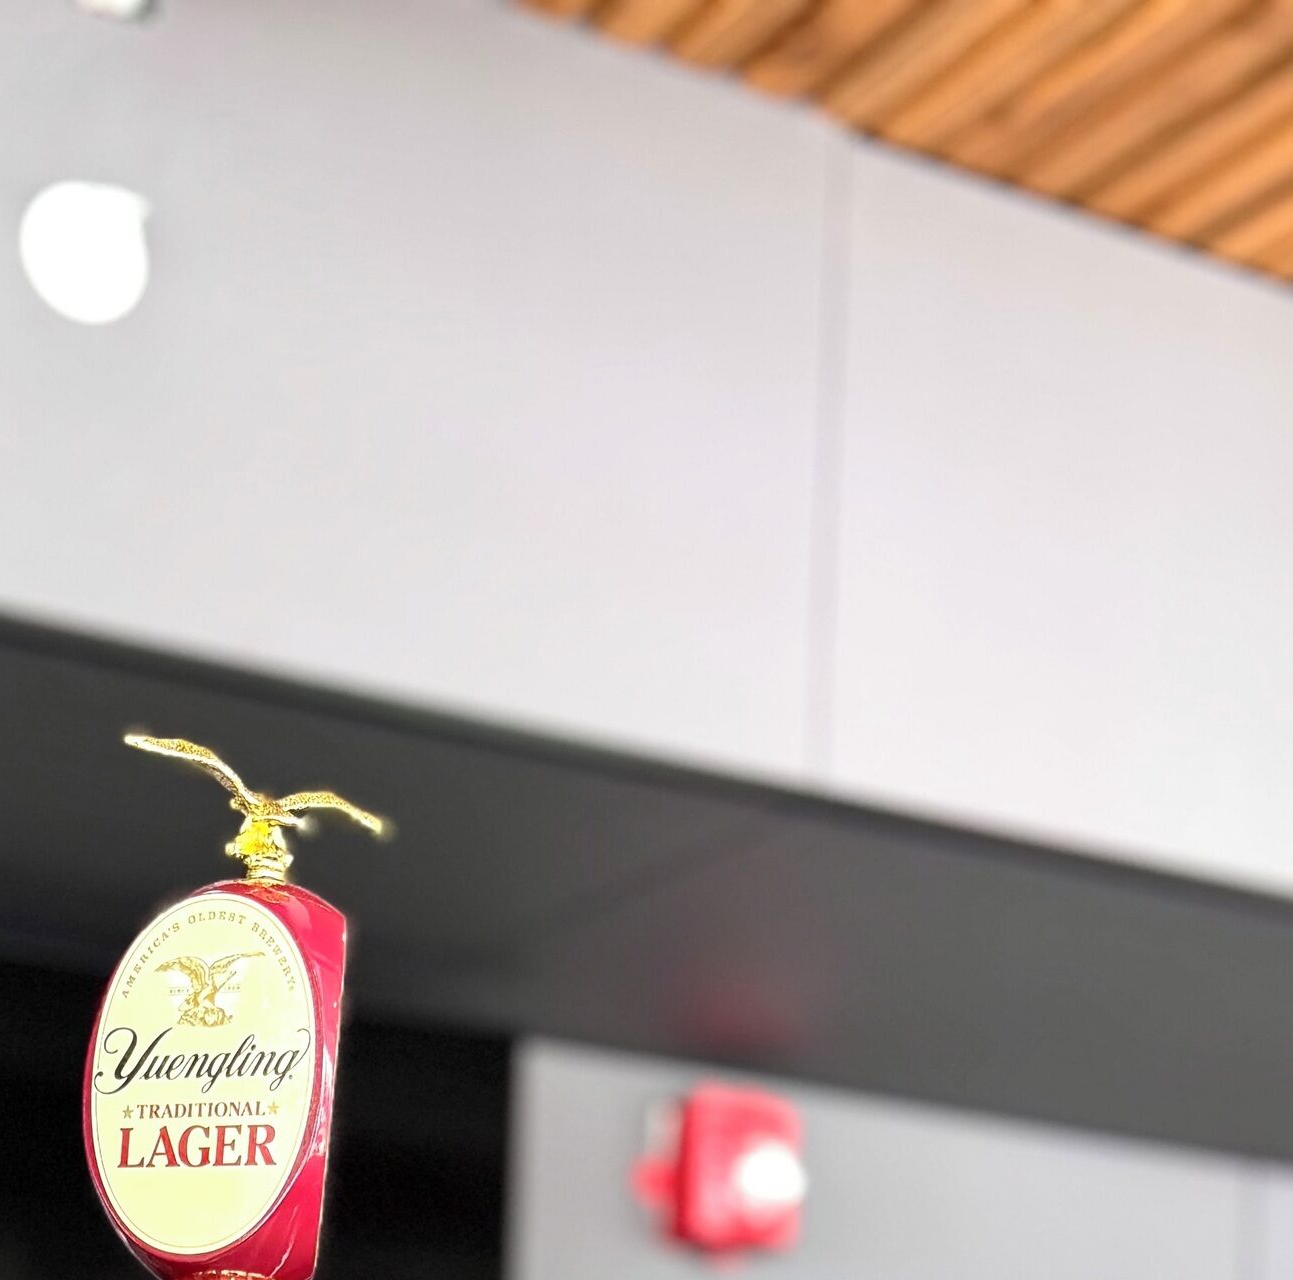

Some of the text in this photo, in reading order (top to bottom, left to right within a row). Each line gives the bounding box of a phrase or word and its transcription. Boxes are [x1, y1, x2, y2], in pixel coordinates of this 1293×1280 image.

[121, 911, 297, 998] AMERICA'S OLDEST BREWERY
[94, 1027, 311, 1094] Yuengling
[136, 1101, 266, 1119] TRADITIONAL
[117, 1124, 277, 1168] LAGER
